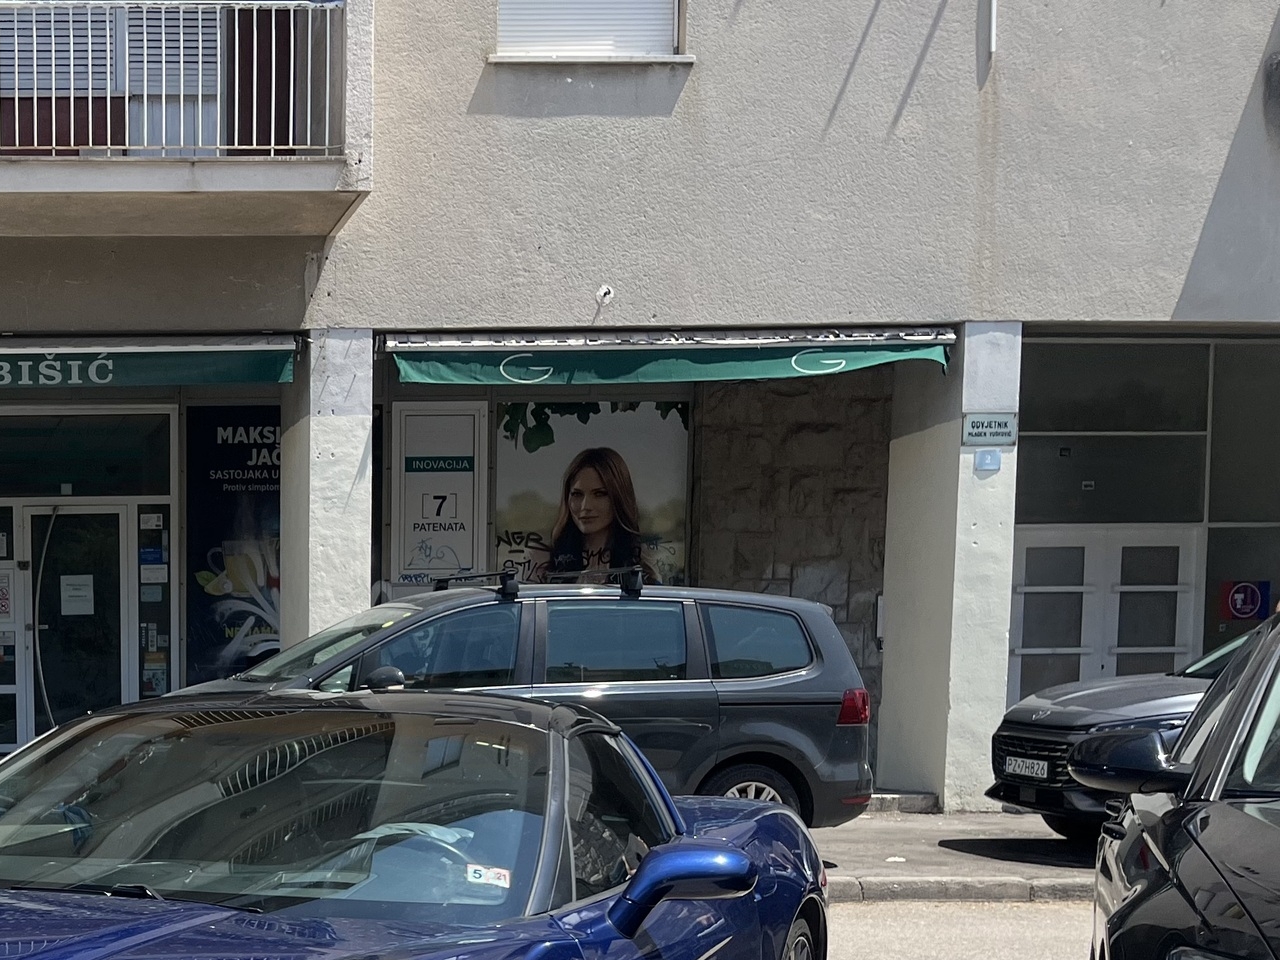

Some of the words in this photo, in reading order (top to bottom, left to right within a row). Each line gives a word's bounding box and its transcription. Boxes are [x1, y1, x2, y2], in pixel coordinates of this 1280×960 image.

[412, 460, 470, 469] INOVACIJA
[209, 470, 269, 479] SASTOJAKA
[223, 483, 246, 491] Protiv
[413, 522, 466, 532] PATENATA
[472, 869, 483, 879] 5
